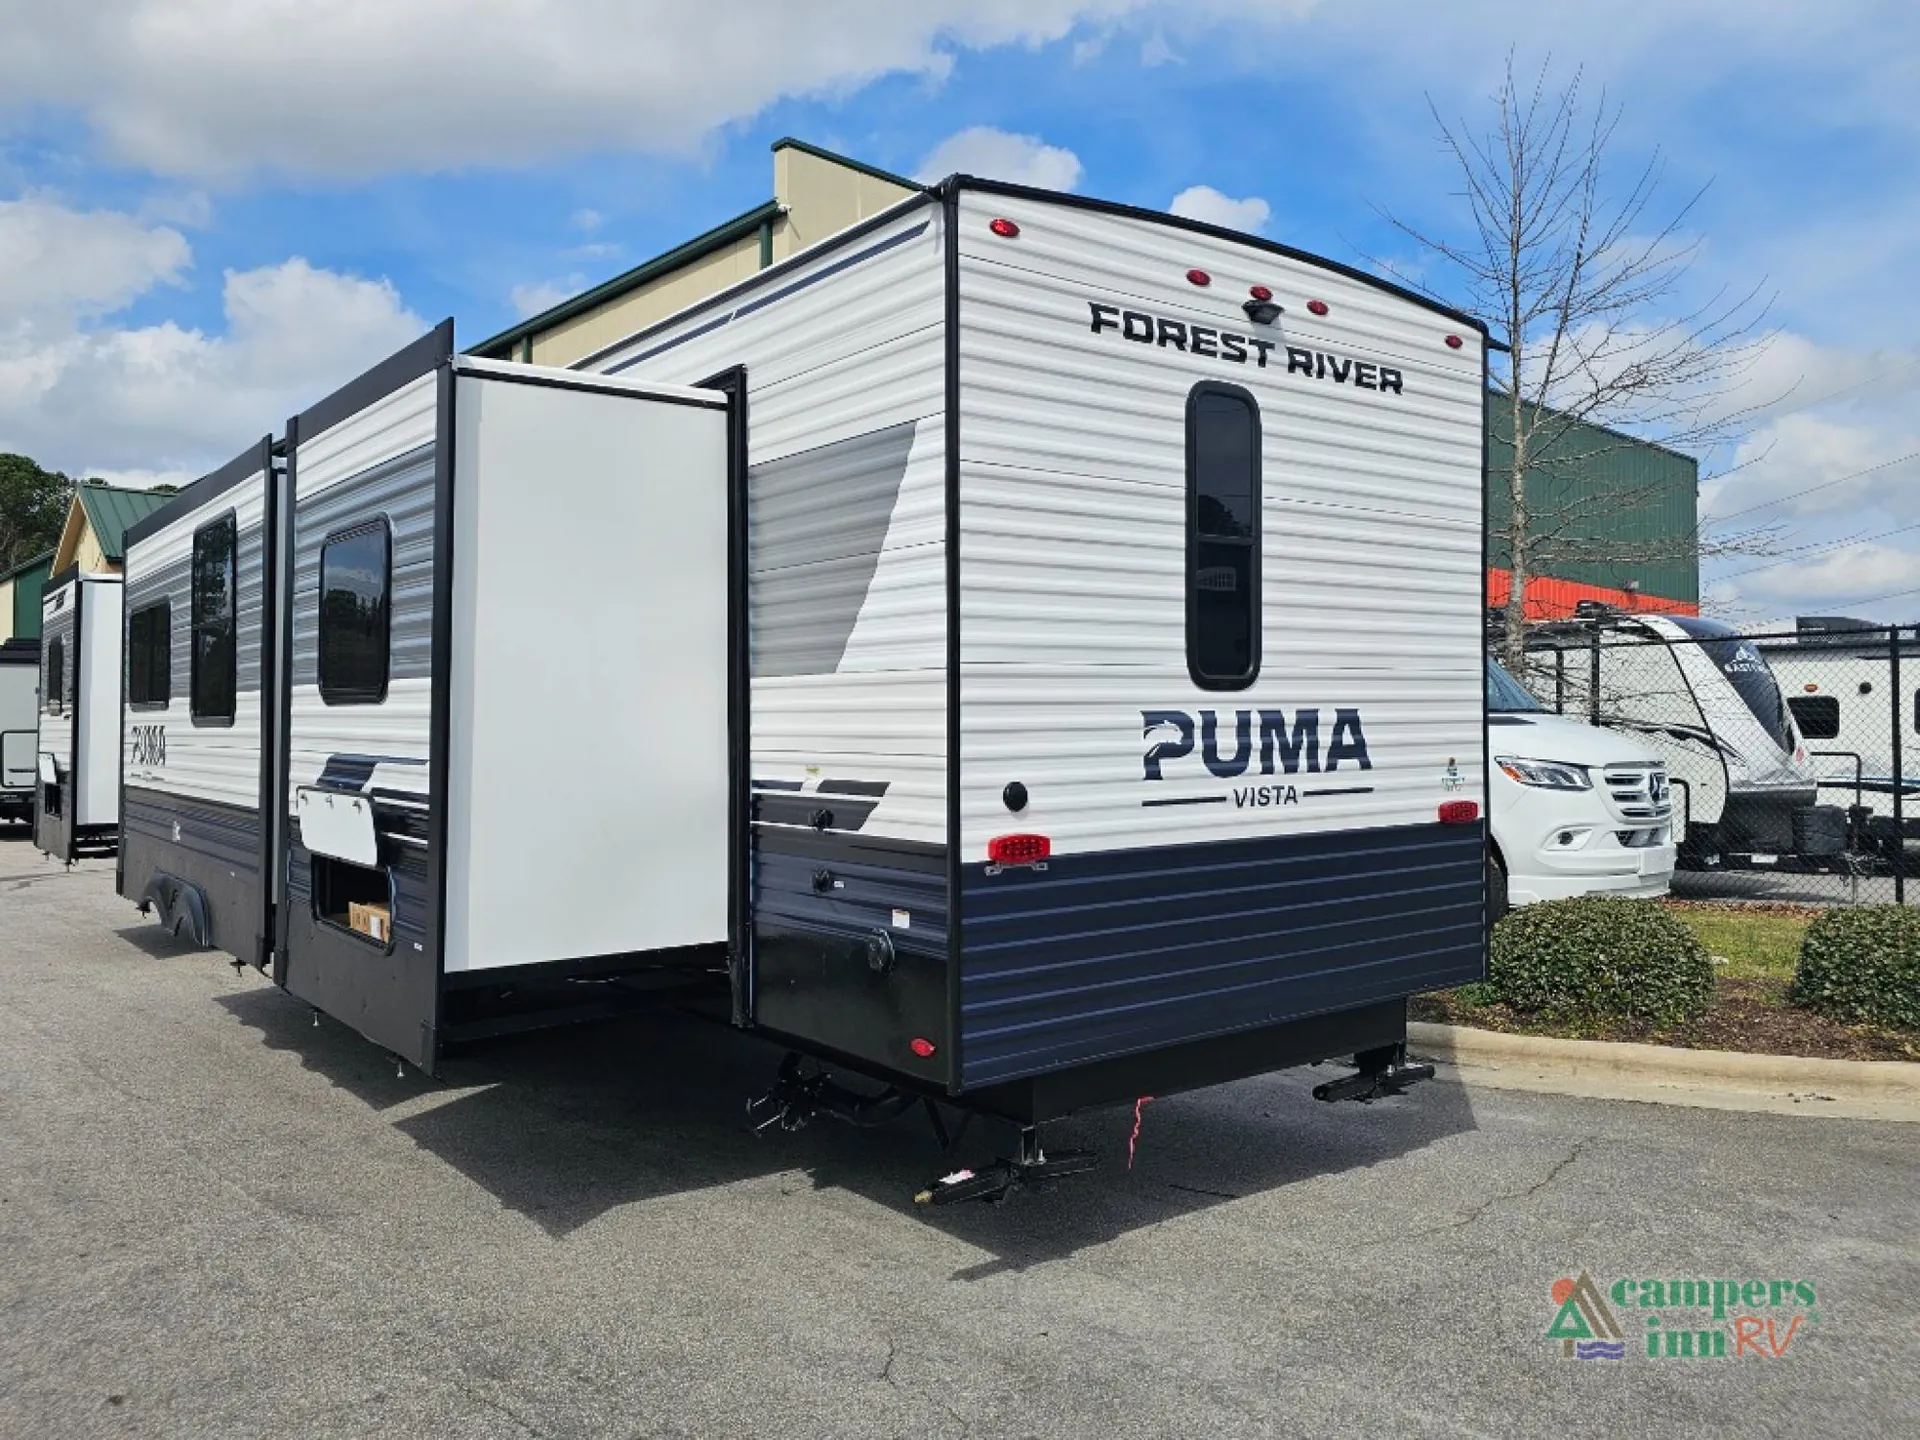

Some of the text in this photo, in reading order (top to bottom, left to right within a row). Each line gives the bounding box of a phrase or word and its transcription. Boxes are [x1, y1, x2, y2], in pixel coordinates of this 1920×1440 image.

[1087, 301, 1404, 396] FOREST RIVER
[131, 724, 166, 767] PUMA
[1140, 708, 1373, 780] PUMA
[1233, 785, 1298, 809] VISTA
